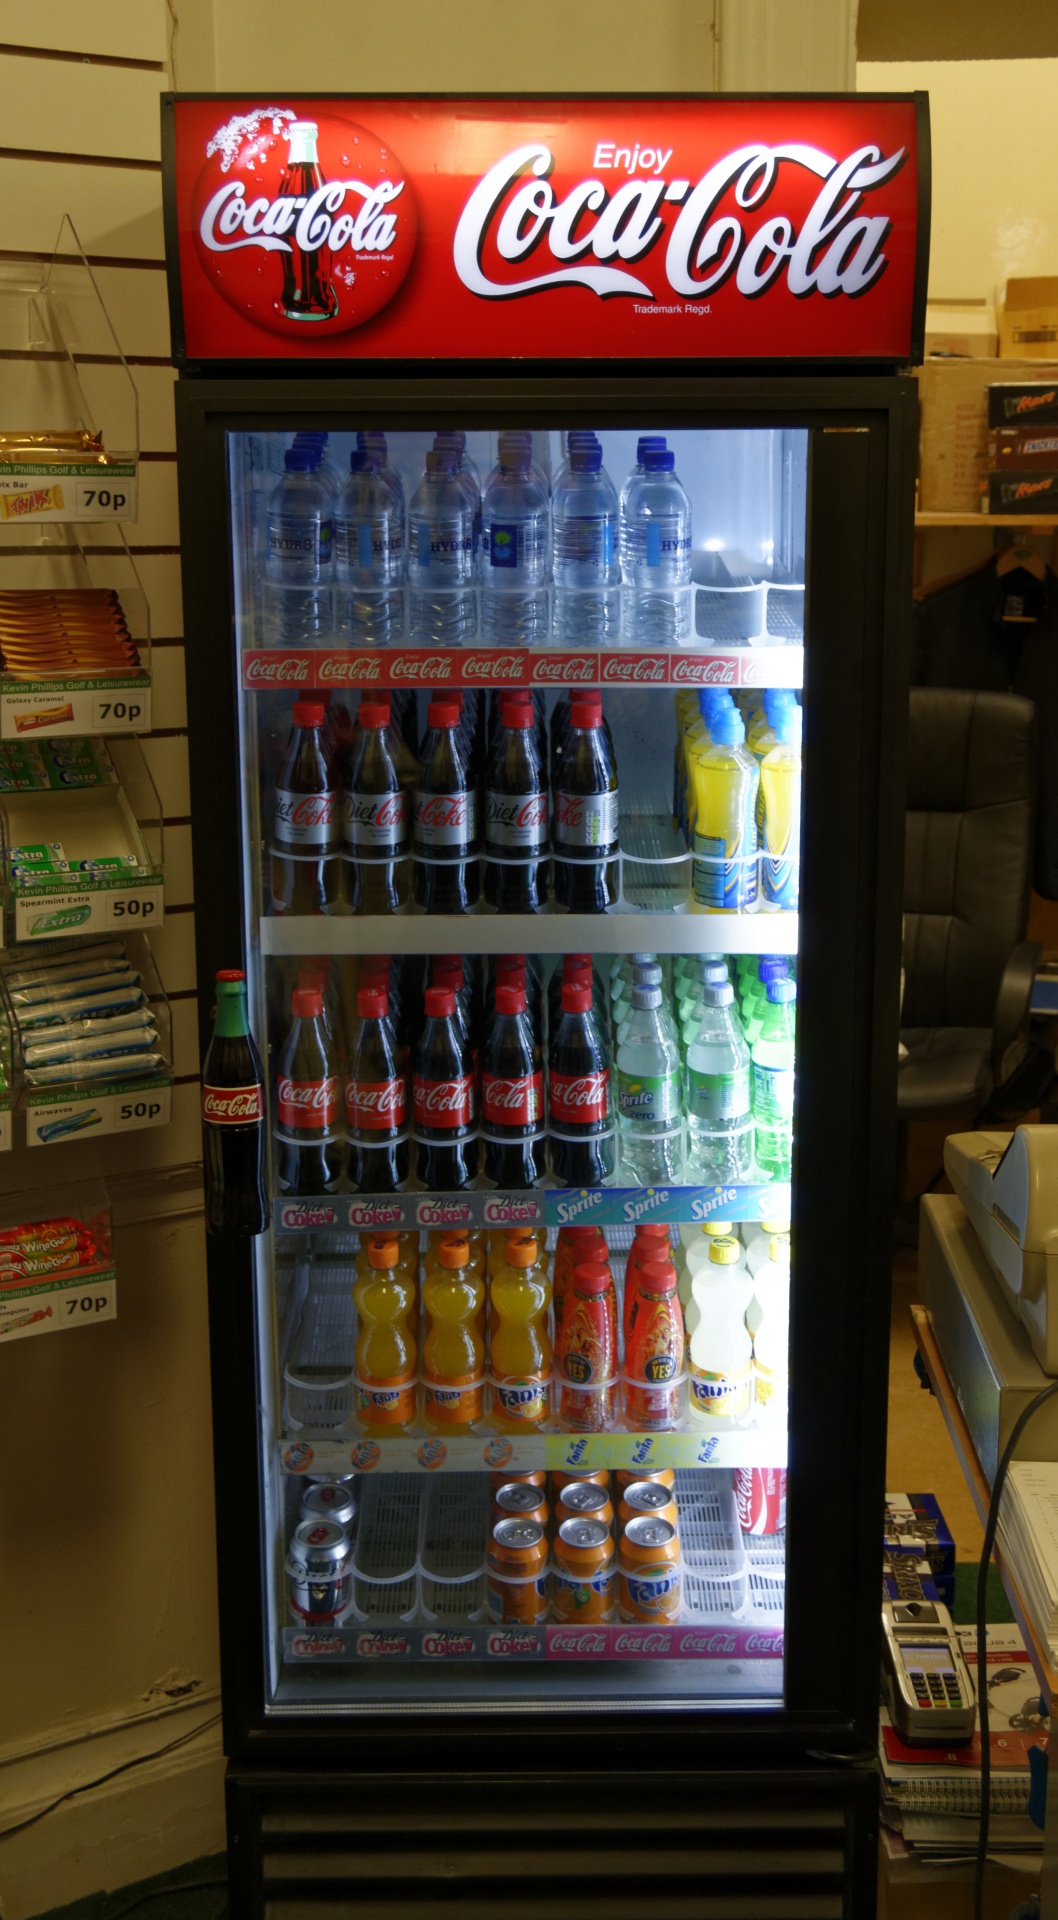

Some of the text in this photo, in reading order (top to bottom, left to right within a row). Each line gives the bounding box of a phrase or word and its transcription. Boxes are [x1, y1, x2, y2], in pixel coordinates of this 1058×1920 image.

[592, 143, 673, 175] Enjoy
[200, 180, 405, 252] Coca-Cola
[453, 144, 906, 297] Coca-Cola
[632, 304, 713, 316] Trademark Regd.
[0, 465, 135, 475] vin Phillips Golf & Leisurewear
[13, 481, 29, 489] Bar
[83, 490, 126, 511] 70p
[246, 658, 311, 681] Coca-Cola
[318, 657, 382, 680] Coca-Cola
[389, 656, 454, 679] Coca-Cola
[461, 656, 525, 679] Coca-Cola
[532, 658, 596, 681] Coca-Cola
[603, 659, 667, 681] Coca-Cola
[672, 659, 738, 683] Coca-Cola
[3, 683, 29, 692] Kevin
[31, 682, 64, 691] Phillips
[66, 681, 85, 689] Golf
[96, 679, 150, 688] Leisurewear
[99, 703, 141, 721] 70p
[276, 797, 294, 816] iet
[422, 796, 469, 827] Coke
[517, 796, 549, 827] Cok
[555, 794, 585, 827] oke
[10, 849, 44, 860] Extra
[18, 887, 43, 896] Kevin
[46, 884, 78, 893] Phillips
[80, 881, 98, 890] Golf
[110, 876, 162, 888] Leisurewear
[20, 895, 90, 907] Spearmint Extra
[113, 900, 154, 917] 50p
[41, 912, 82, 928] Extra
[30, 1079, 170, 1105] Kevin Phillips Golf & Leisurewear
[278, 1076, 338, 1109] Coca-Co
[620, 1087, 654, 1110] Sprite
[33, 1106, 73, 1117] Airwaves
[120, 1102, 161, 1120] 50p
[204, 1092, 259, 1117] Coca-Cola
[629, 1110, 655, 1120] zero
[418, 1205, 462, 1224] Coke
[486, 1203, 529, 1222] Coke
[556, 1190, 602, 1224] Sprite
[623, 1189, 669, 1223] Sprite
[691, 1188, 737, 1222] Sprite
[283, 1209, 326, 1227] Coke
[351, 1207, 394, 1225] Coke
[0, 1287, 30, 1299] Phillips
[32, 1283, 51, 1294] Golf
[62, 1271, 115, 1287] Leisurewear
[66, 1296, 107, 1315] 70p
[568, 1362, 585, 1379] YES
[651, 1364, 671, 1379] YES
[566, 1438, 588, 1466] Fanta
[632, 1437, 654, 1465] Fanta
[698, 1436, 720, 1464] Fanta
[890, 1552, 927, 1600] SRIXO
[294, 1638, 334, 1655] Coke
[359, 1637, 399, 1655] Coke
[424, 1637, 465, 1655] Coke
[490, 1636, 530, 1655] Coke
[550, 1633, 608, 1653] Coca-Cola
[615, 1633, 673, 1653] Coca-Cola
[679, 1633, 737, 1653] Coca-Cola
[745, 1632, 784, 1653] Coca-C
